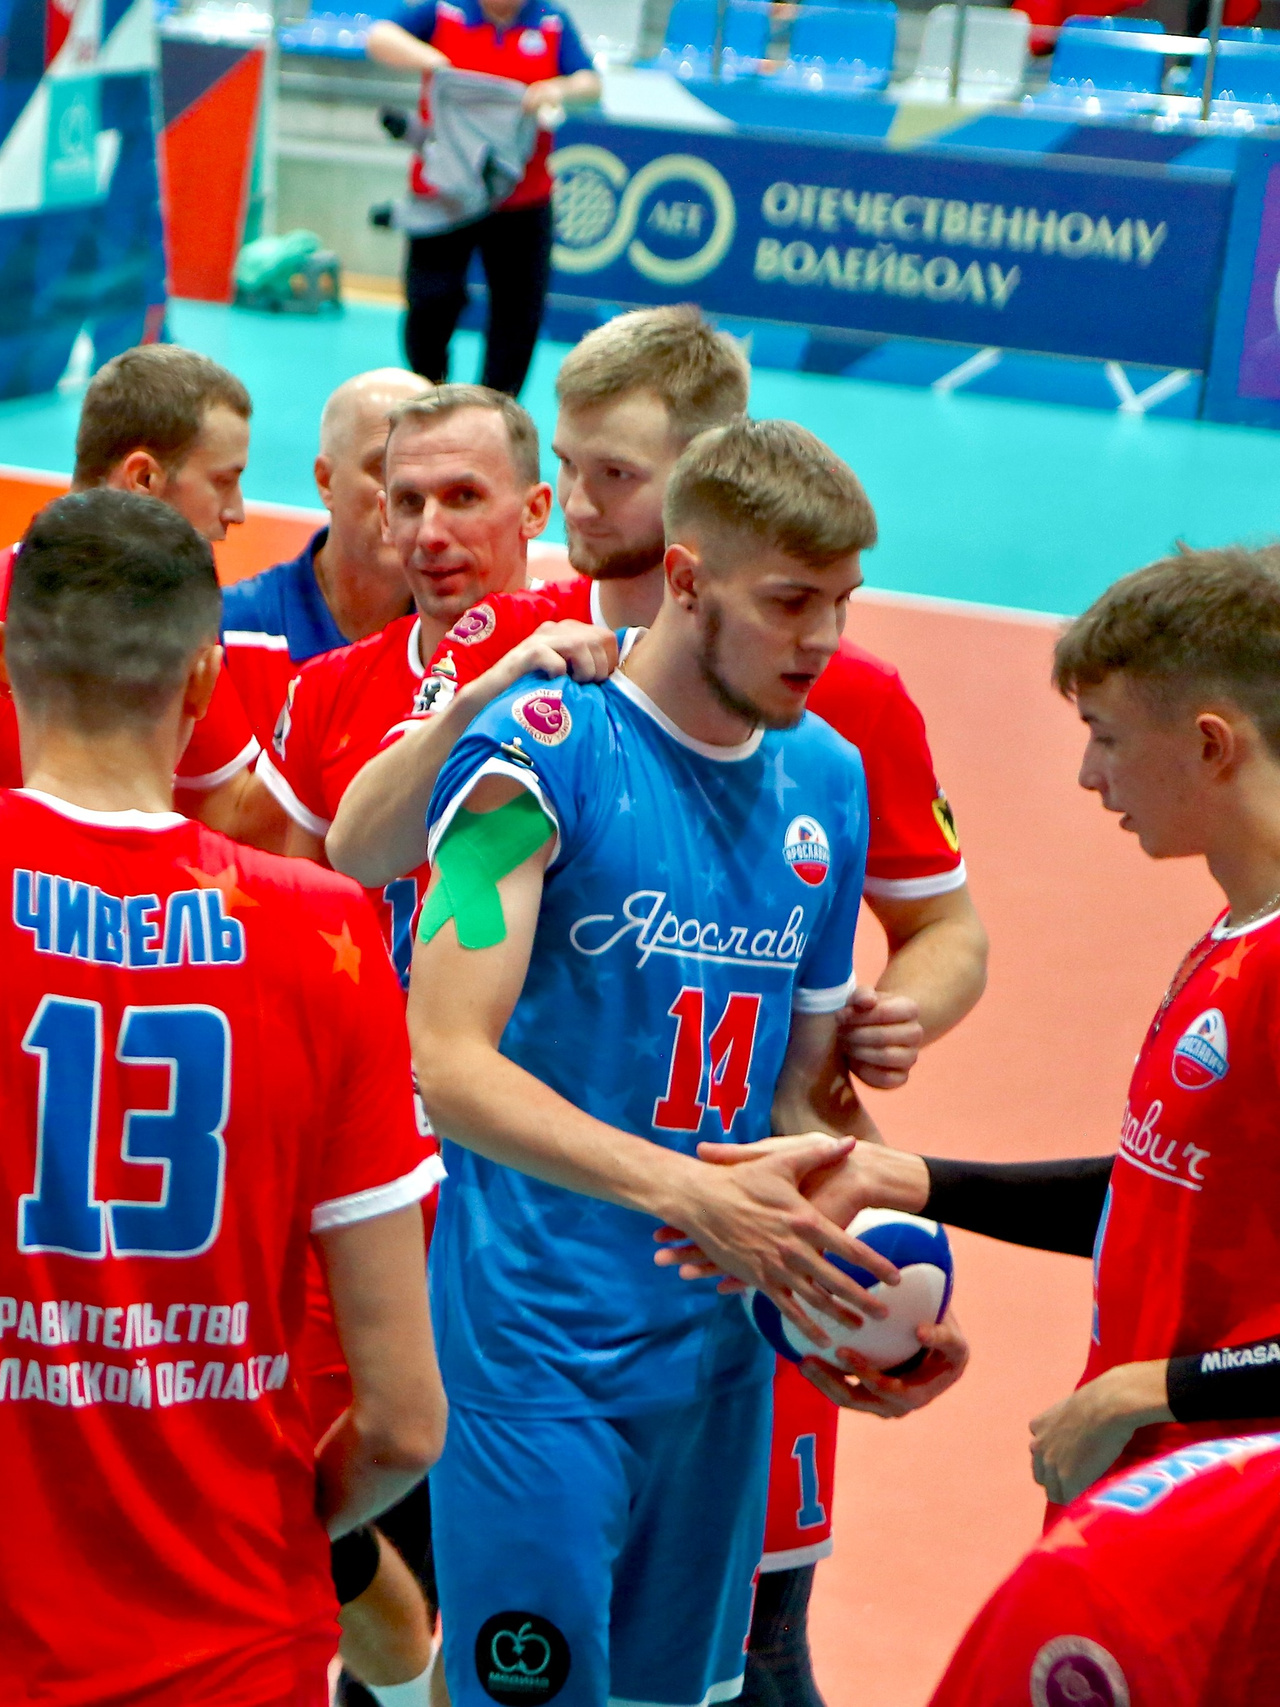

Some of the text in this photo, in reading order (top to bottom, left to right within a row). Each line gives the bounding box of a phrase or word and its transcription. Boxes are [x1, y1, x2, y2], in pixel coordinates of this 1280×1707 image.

[646, 199, 707, 238] ЛЕТ
[761, 181, 1167, 268] ОТЕЧЕСТВЕННОМУ
[755, 236, 1019, 309] ВОЛЕЙБОЛУ
[13, 868, 246, 969] ЧИВЕЛЬ
[652, 985, 762, 1133] 14
[17, 993, 231, 1260] 13
[156, 1352, 289, 1408] ОБЛАСТИ
[791, 1433, 827, 1530] 1
